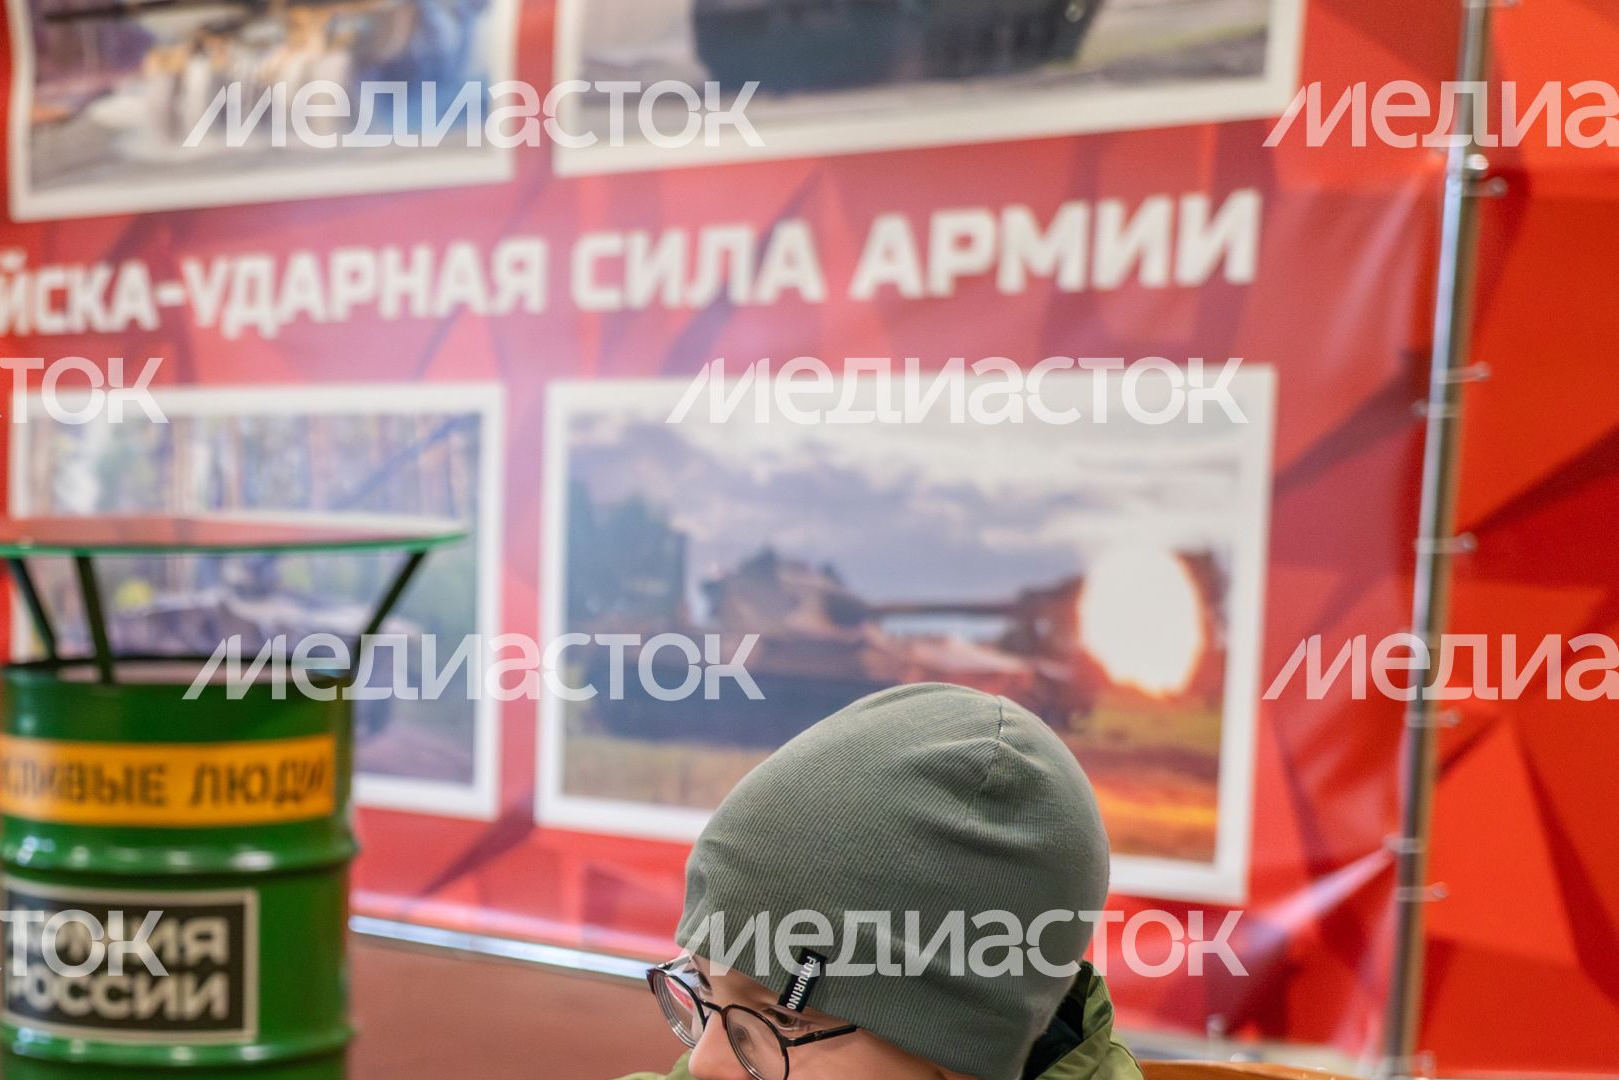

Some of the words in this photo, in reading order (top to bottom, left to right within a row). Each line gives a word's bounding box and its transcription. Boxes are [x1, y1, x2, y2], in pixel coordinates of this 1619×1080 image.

[570, 217, 827, 311] СИЛА
[848, 188, 1262, 299] АРМИИ
[189, 758, 324, 808] ЛЮДИ
[786, 955, 816, 1010] FUTURINO
